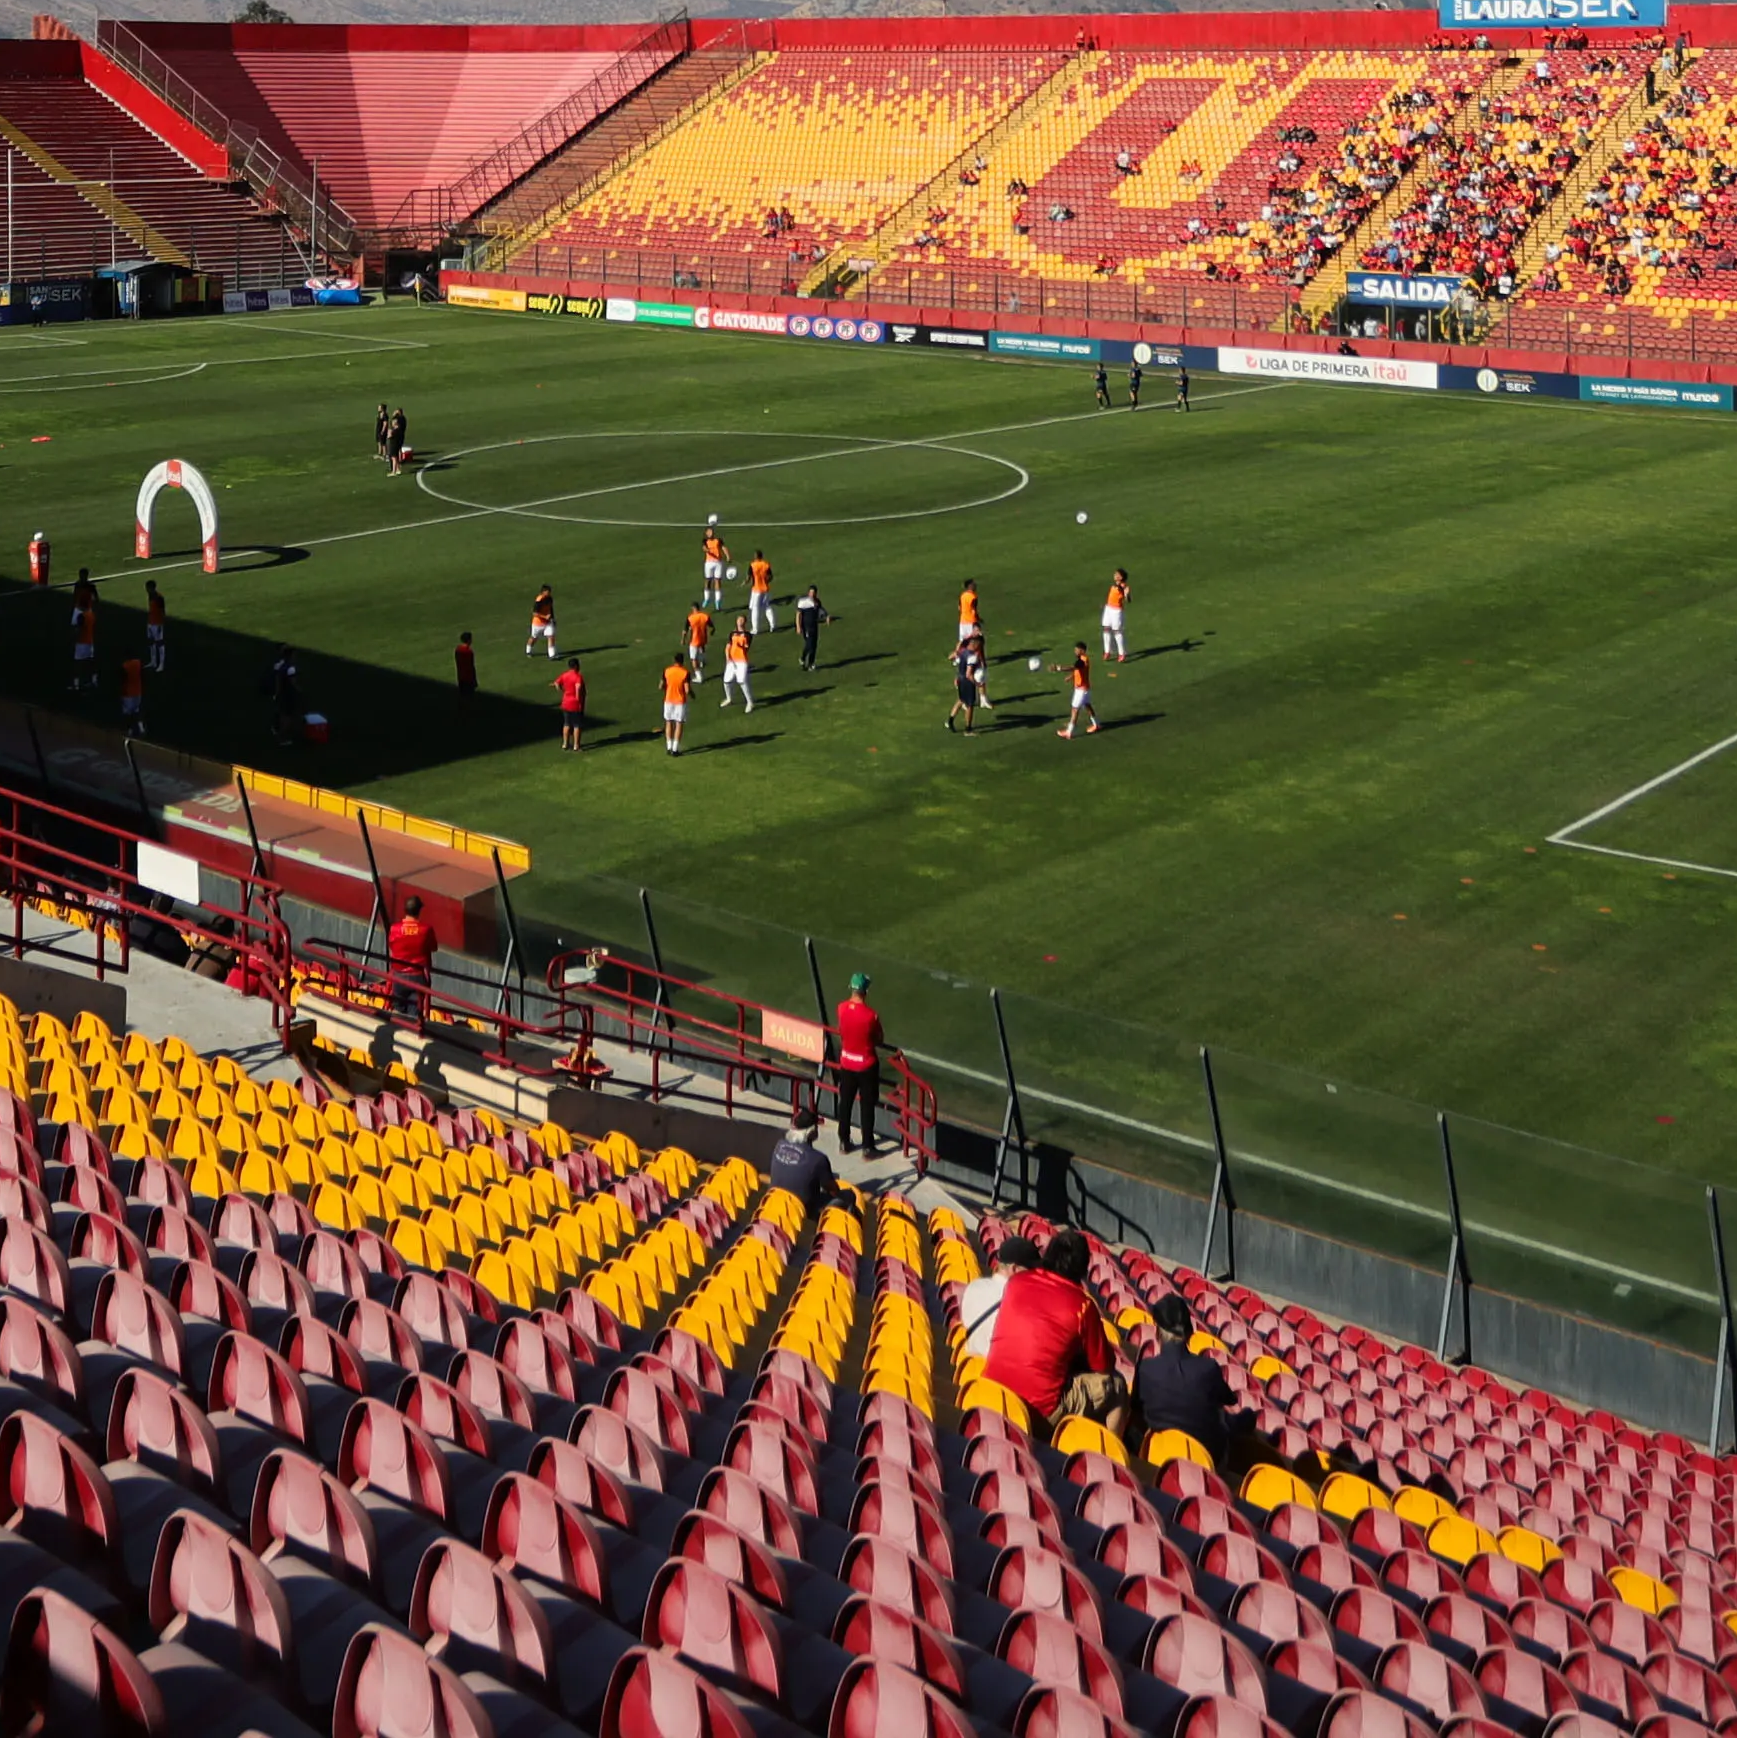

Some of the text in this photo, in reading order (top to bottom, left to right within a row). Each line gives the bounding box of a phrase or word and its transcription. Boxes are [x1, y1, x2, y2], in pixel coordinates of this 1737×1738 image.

[50, 288, 83, 302] SEK
[1363, 278, 1451, 302] SALIDA
[713, 309, 786, 332] GATORADE
[1259, 358, 1407, 381] LIGA DE PRIMERA itaú
[1506, 382, 1531, 393] SEK
[1681, 391, 1720, 403] mundo
[770, 1024, 816, 1052] SALIDA
